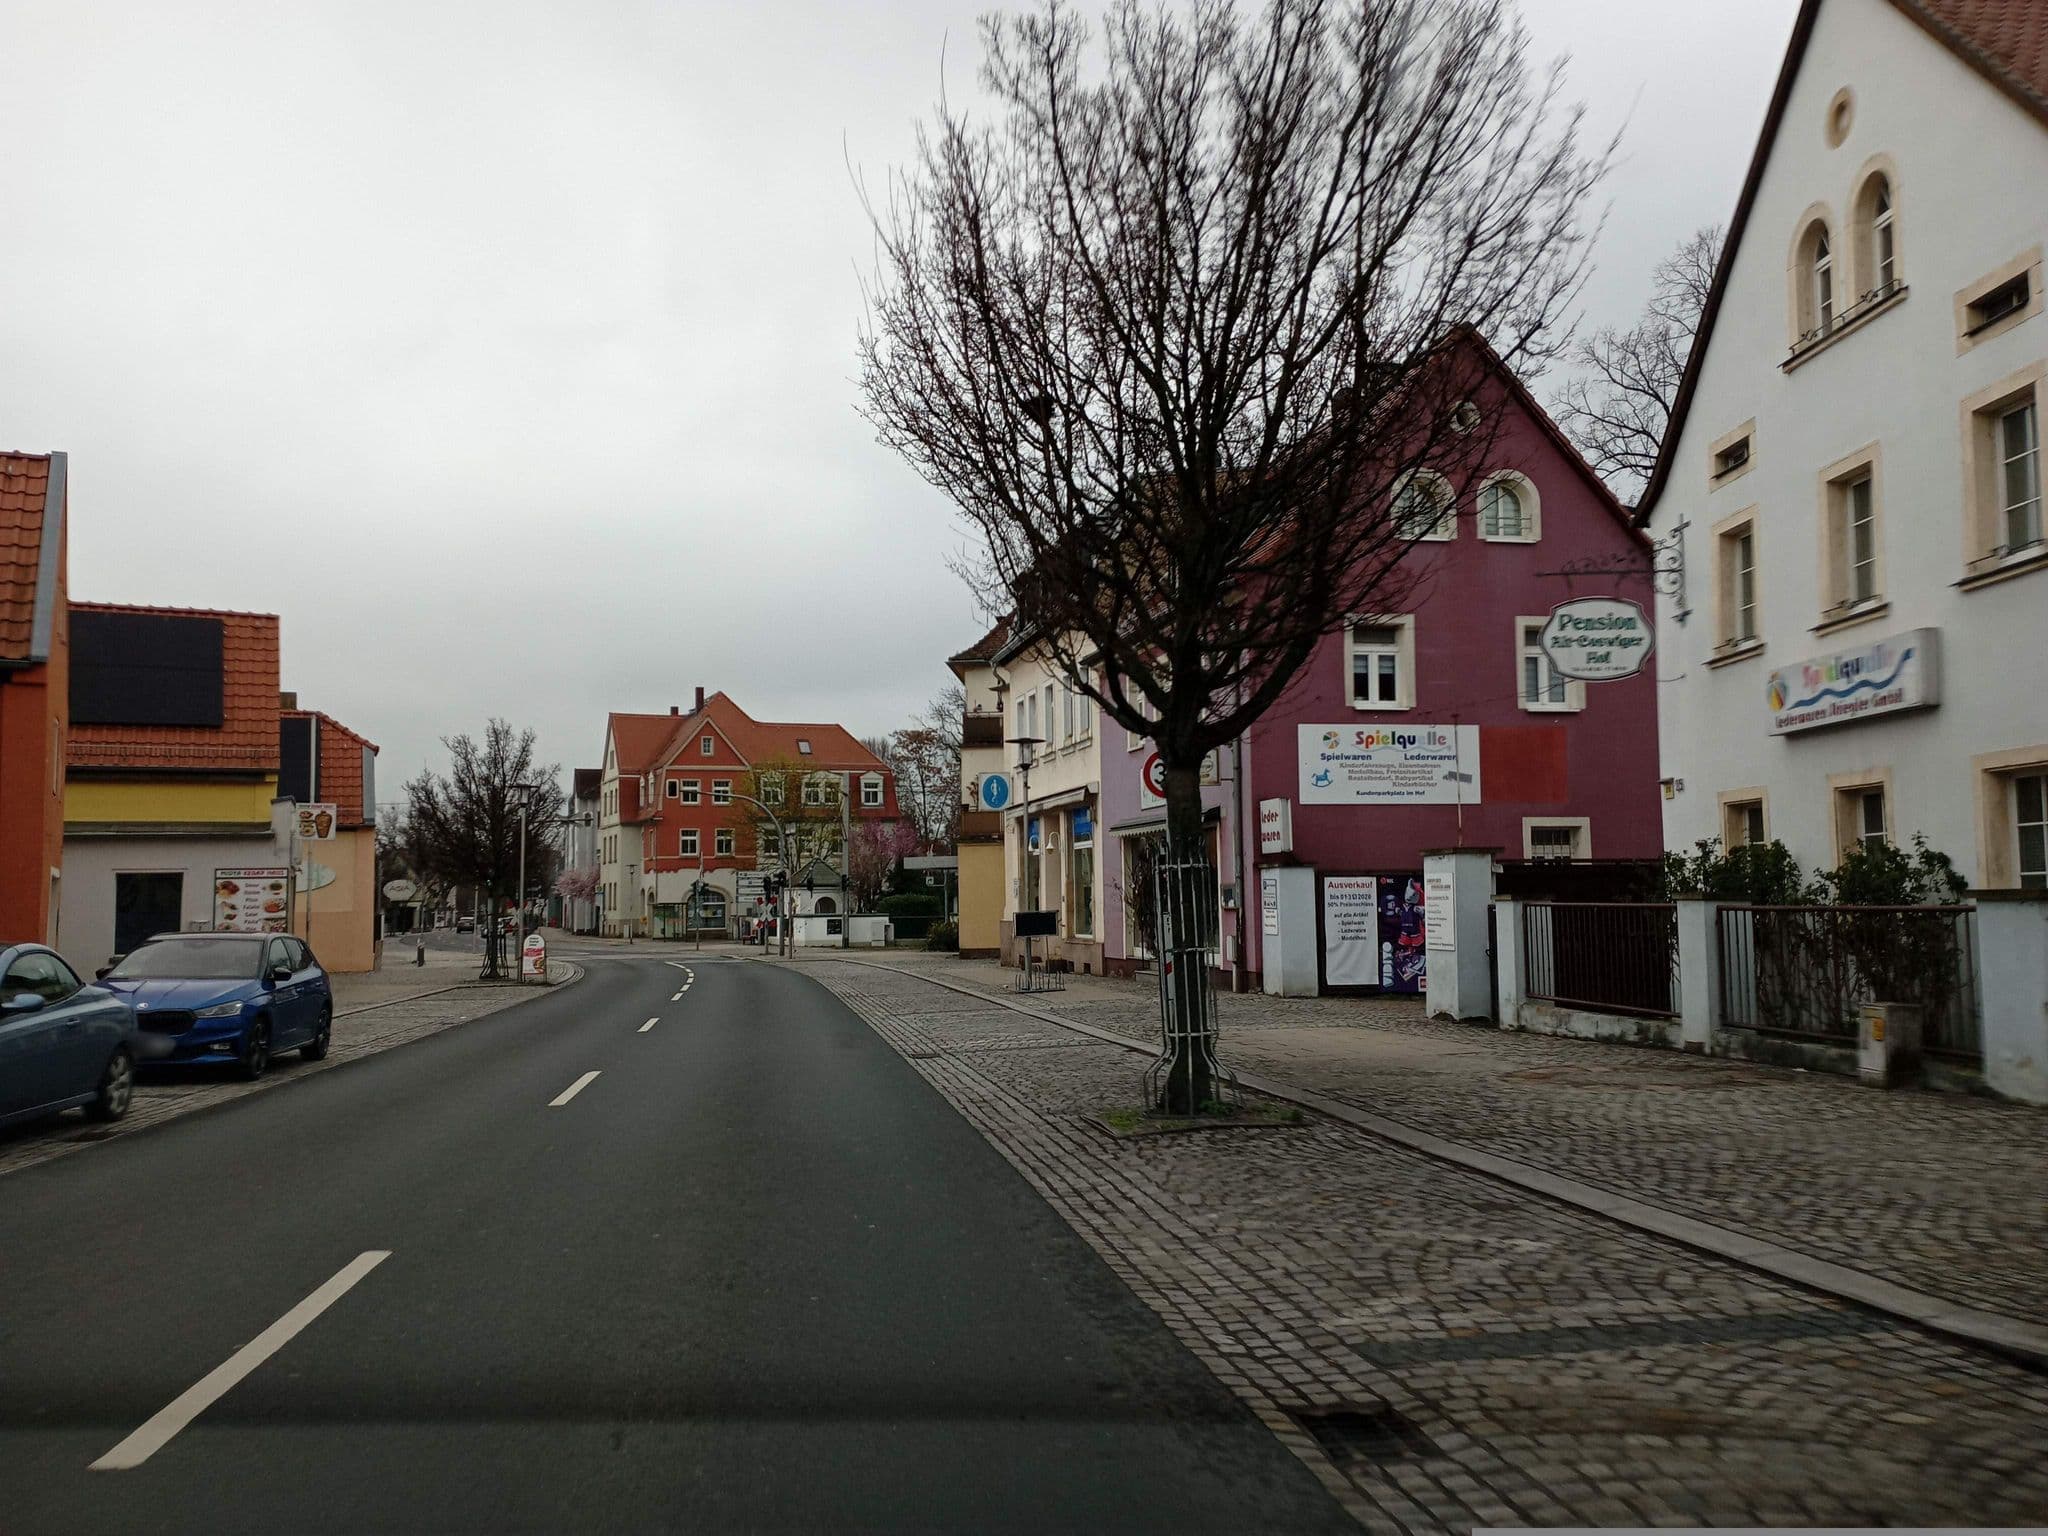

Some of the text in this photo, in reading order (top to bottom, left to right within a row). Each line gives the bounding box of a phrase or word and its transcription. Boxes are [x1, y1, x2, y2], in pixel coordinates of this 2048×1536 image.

[1558, 612, 1636, 631] Pension
[1355, 729, 1447, 749] Spielquelle
[1320, 752, 1372, 762] Spielwaren
[1154, 763, 1166, 784] 3
[1328, 881, 1373, 889] Ausverkauf
